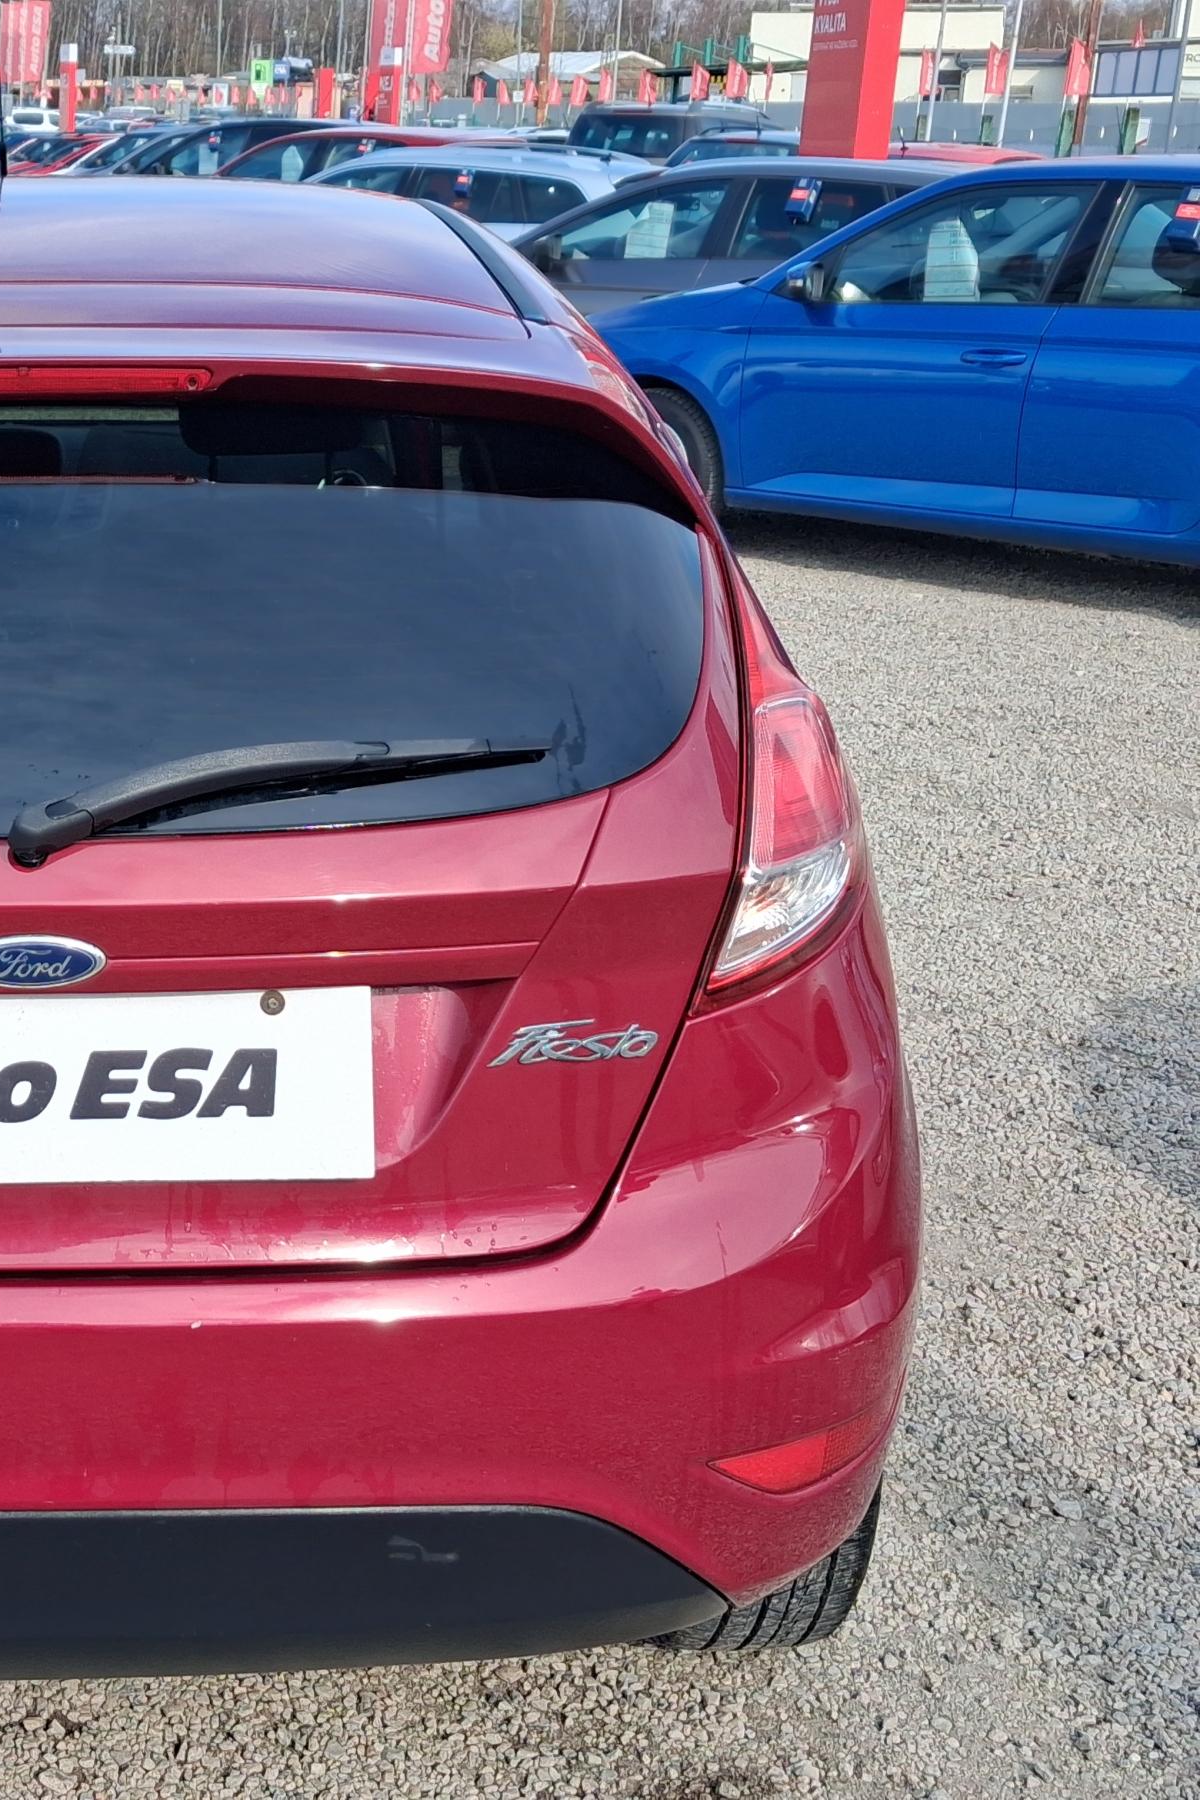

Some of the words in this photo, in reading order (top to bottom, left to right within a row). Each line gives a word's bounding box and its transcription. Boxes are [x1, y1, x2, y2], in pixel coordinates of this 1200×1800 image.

[423, 0, 445, 63] Auto
[814, 11, 847, 34] KVALITA
[486, 1018, 658, 1067] Fiesta
[69, 1048, 278, 1120] ESA
